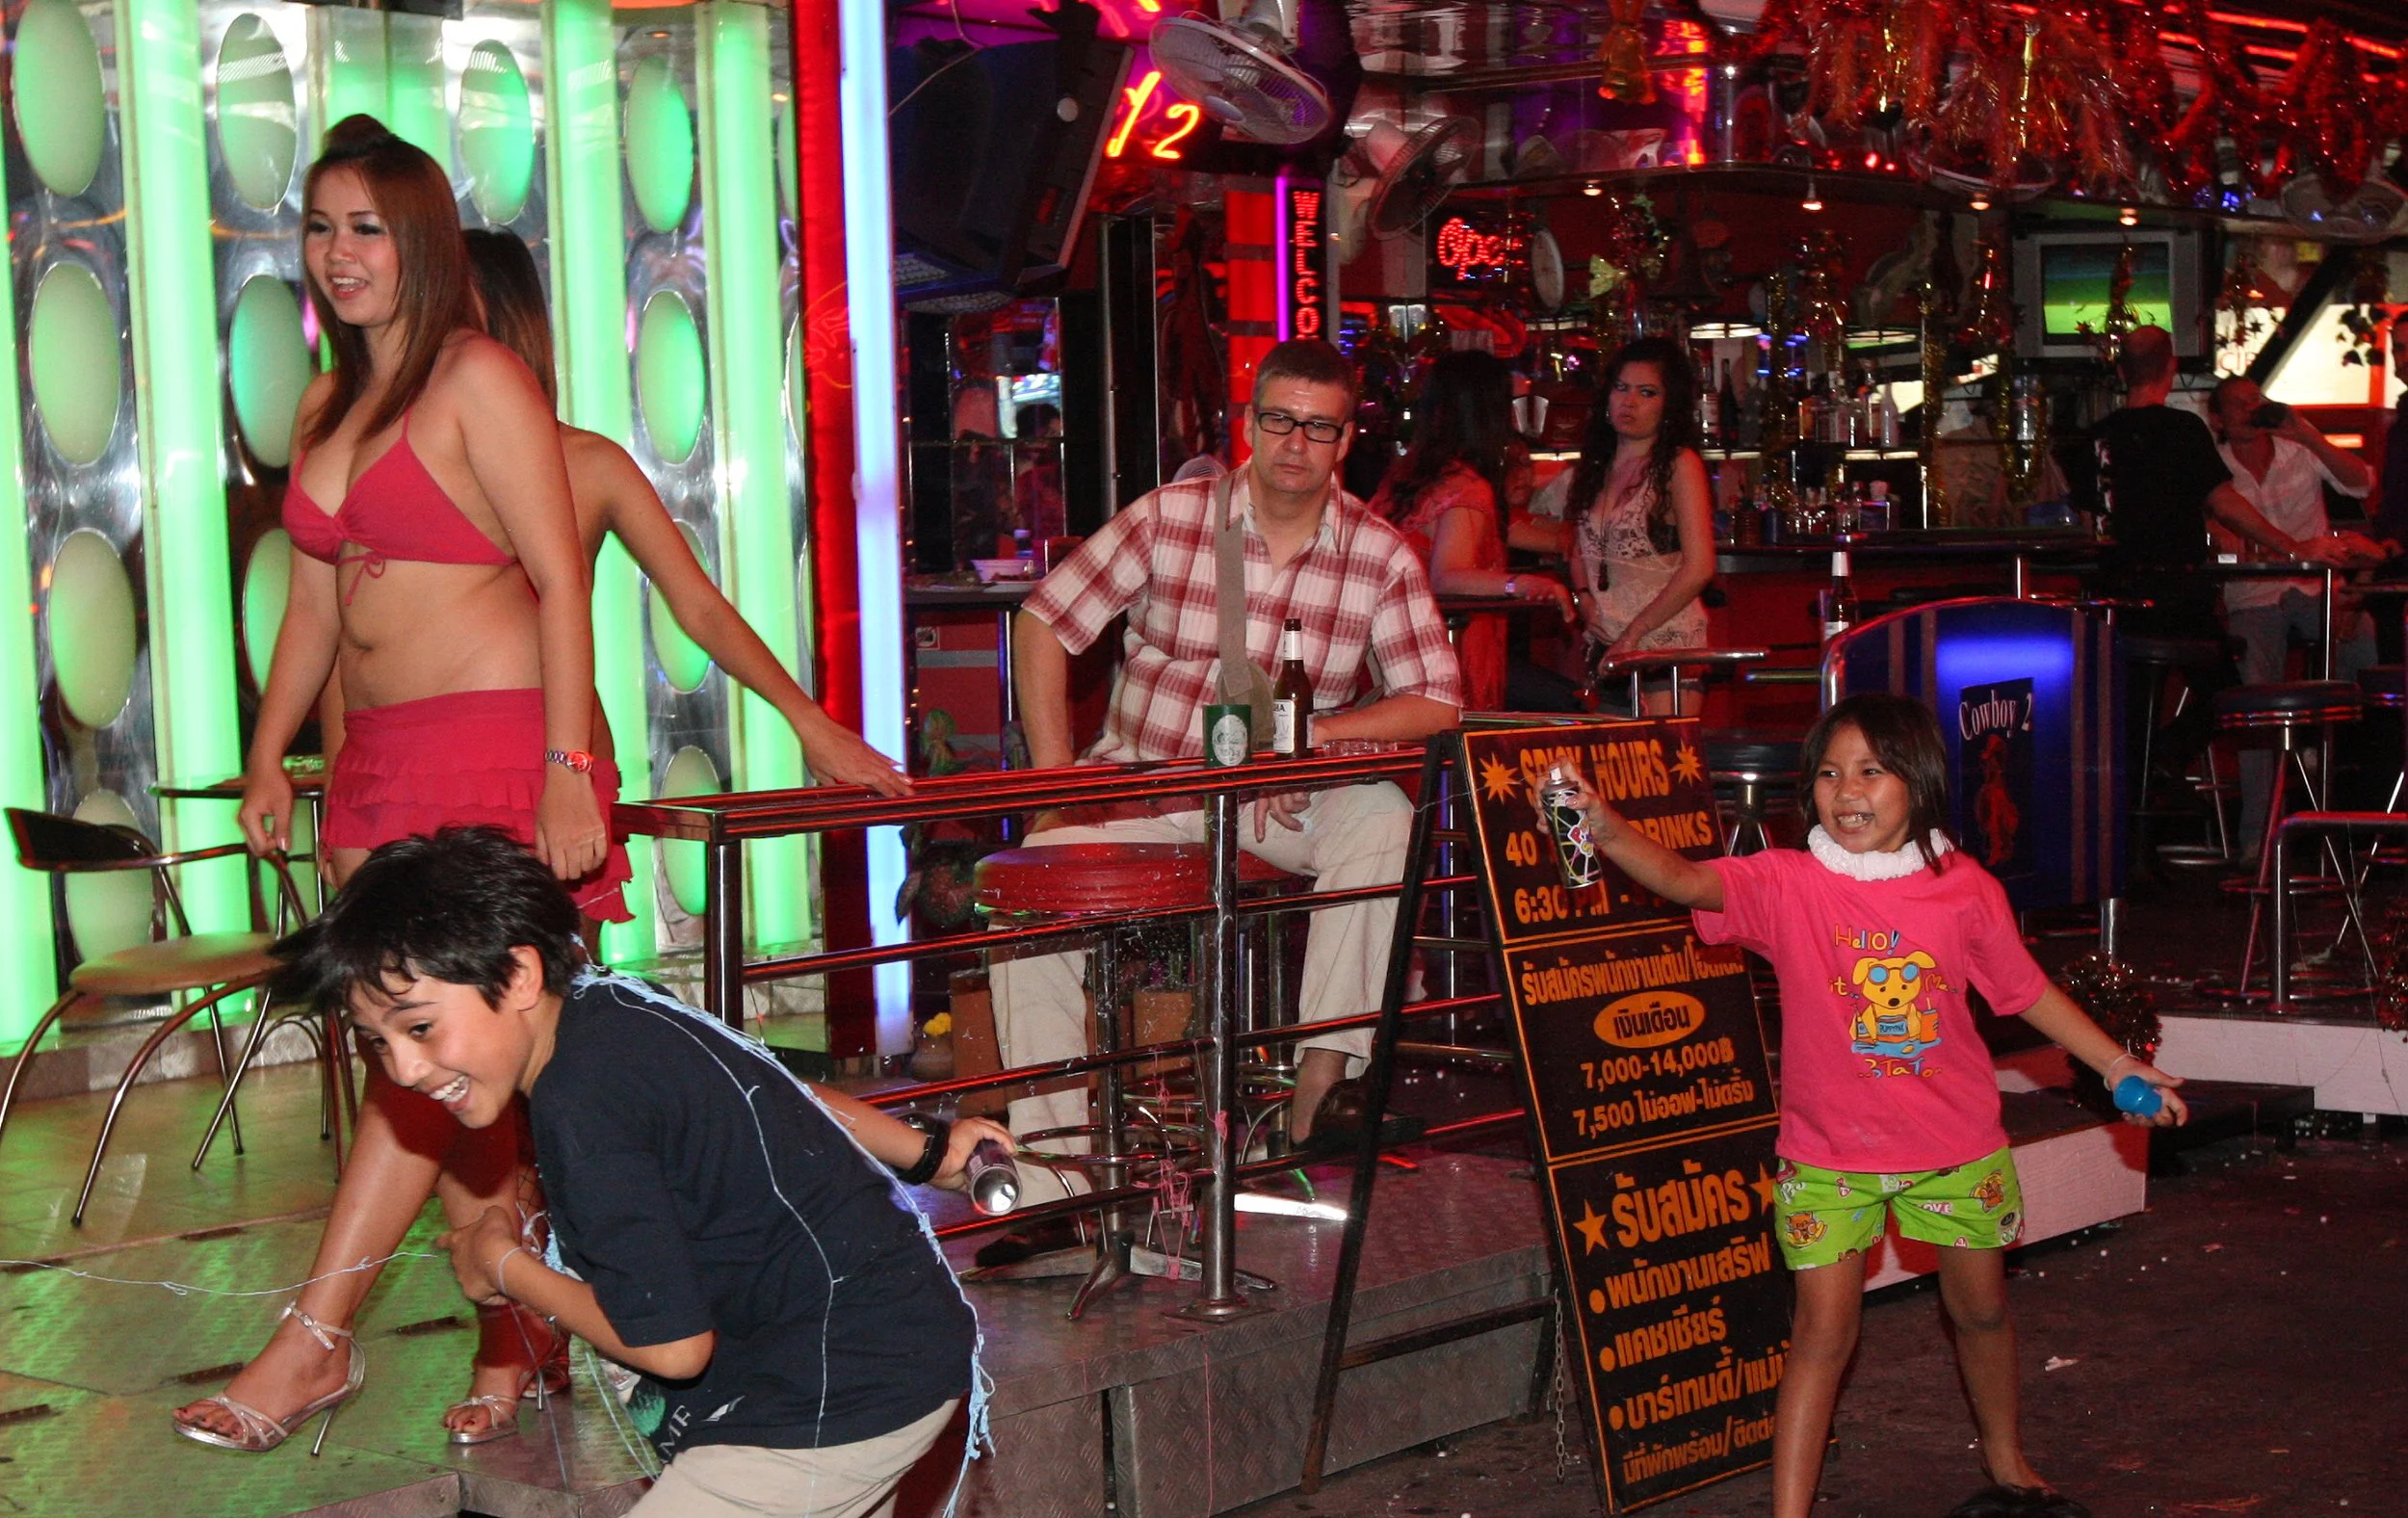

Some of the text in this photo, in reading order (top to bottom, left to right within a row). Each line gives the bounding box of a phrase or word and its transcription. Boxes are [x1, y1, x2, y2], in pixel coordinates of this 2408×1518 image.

[1293, 190, 1322, 340] WELCO
[1958, 690, 2034, 741] Cowboy 2
[1590, 738, 1670, 801] HOURS
[1505, 830, 1538, 868] 40
[1629, 811, 1713, 851] RINKS
[1612, 1000, 1691, 1041] เงินเดือน
[1572, 1107, 1636, 1139] 7,500
[1611, 1158, 1752, 1249] รับสมัคร
[1922, 1202, 1952, 1215] OVE
[1605, 1232, 1772, 1311] พนักงานเสริฟ
[1614, 1295, 1728, 1369] แคชเชียร์
